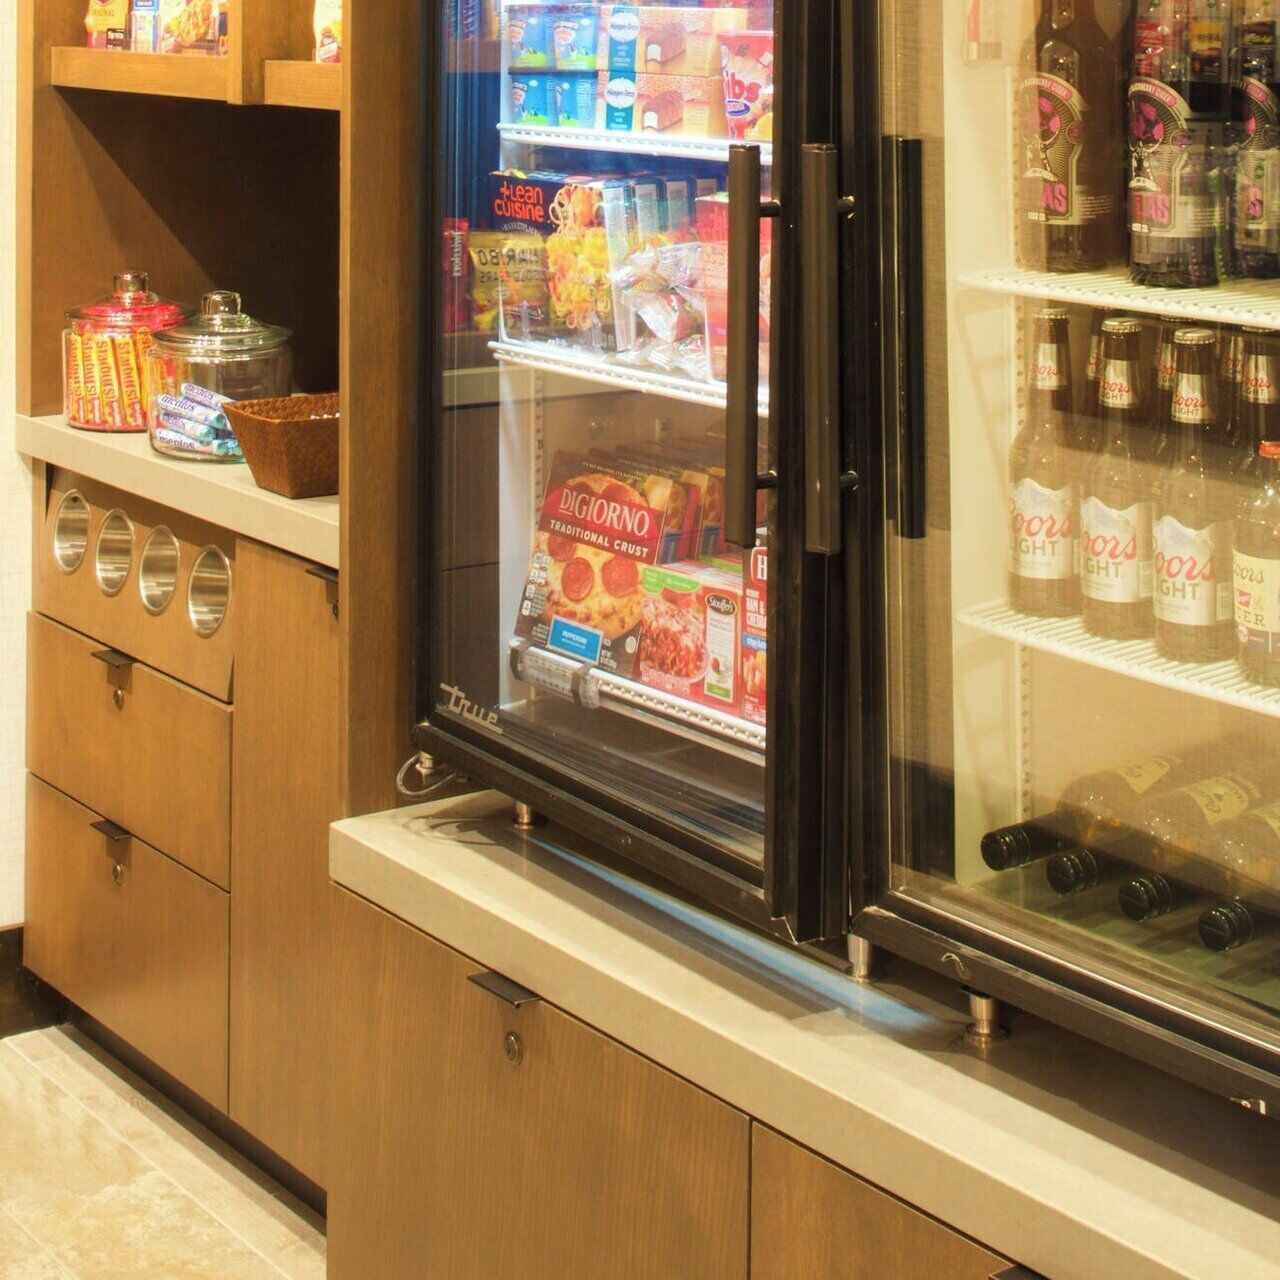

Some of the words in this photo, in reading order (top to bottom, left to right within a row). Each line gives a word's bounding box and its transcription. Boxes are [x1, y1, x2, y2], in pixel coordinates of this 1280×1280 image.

[96, 340, 116, 400] STARBURST
[120, 341, 137, 401] STARBURST
[159, 436, 195, 449] mentos
[549, 520, 610, 547] TRADITIONAL
[614, 540, 649, 558] CRUST
[1153, 551, 1215, 582] oors
[1155, 582, 1200, 600] IGHT
[1235, 609, 1265, 627] EER
